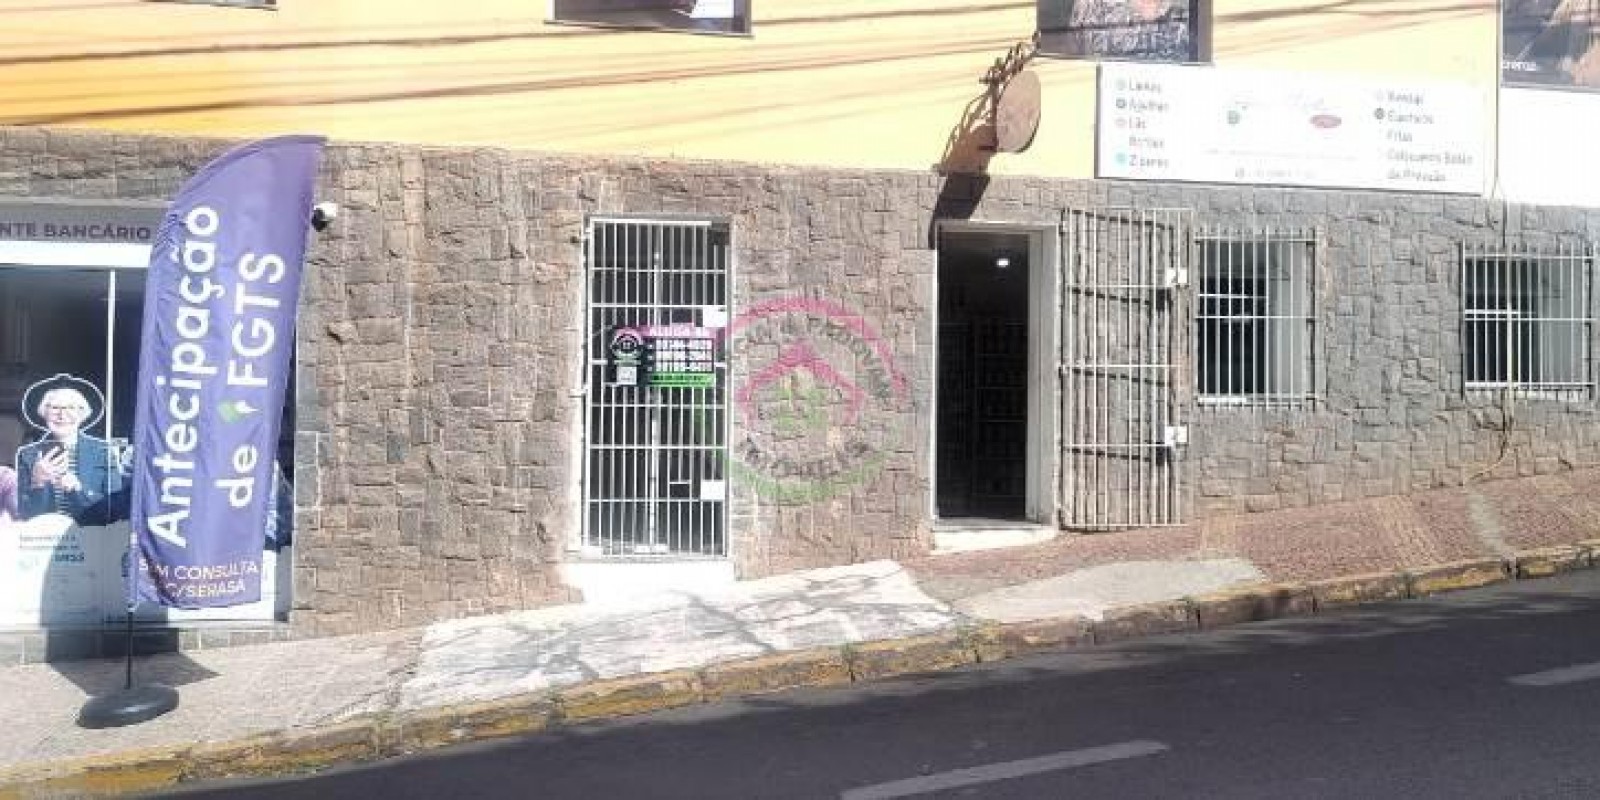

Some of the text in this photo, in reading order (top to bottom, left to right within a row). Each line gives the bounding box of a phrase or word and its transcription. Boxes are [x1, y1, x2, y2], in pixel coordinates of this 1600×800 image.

[44, 222, 151, 240] BANCÁRIO
[148, 205, 225, 548] Antecipação
[214, 253, 286, 508] de FGTS
[138, 558, 259, 579] SM CONSULTA
